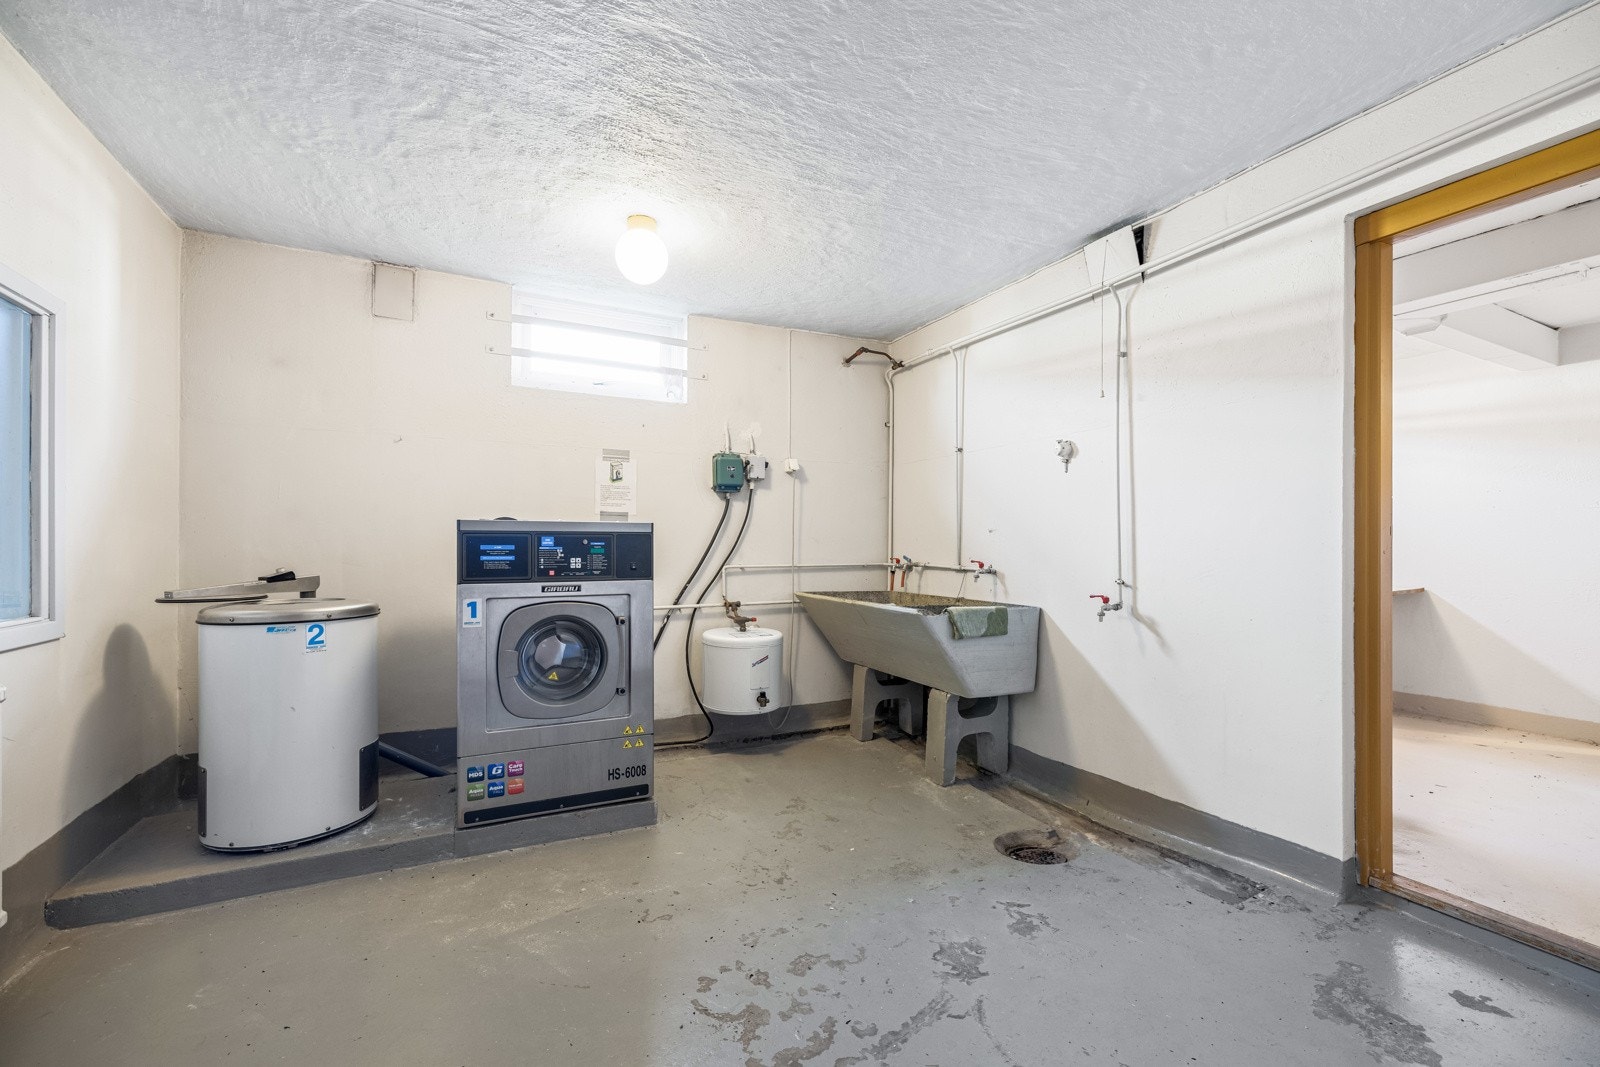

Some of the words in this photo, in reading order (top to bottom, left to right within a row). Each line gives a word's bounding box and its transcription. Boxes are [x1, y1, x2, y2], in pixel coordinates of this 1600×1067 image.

[467, 601, 478, 619] 1
[308, 624, 324, 645] 2
[468, 771, 484, 779] MDS
[492, 766, 503, 775] G
[607, 764, 646, 780] HS-6008
